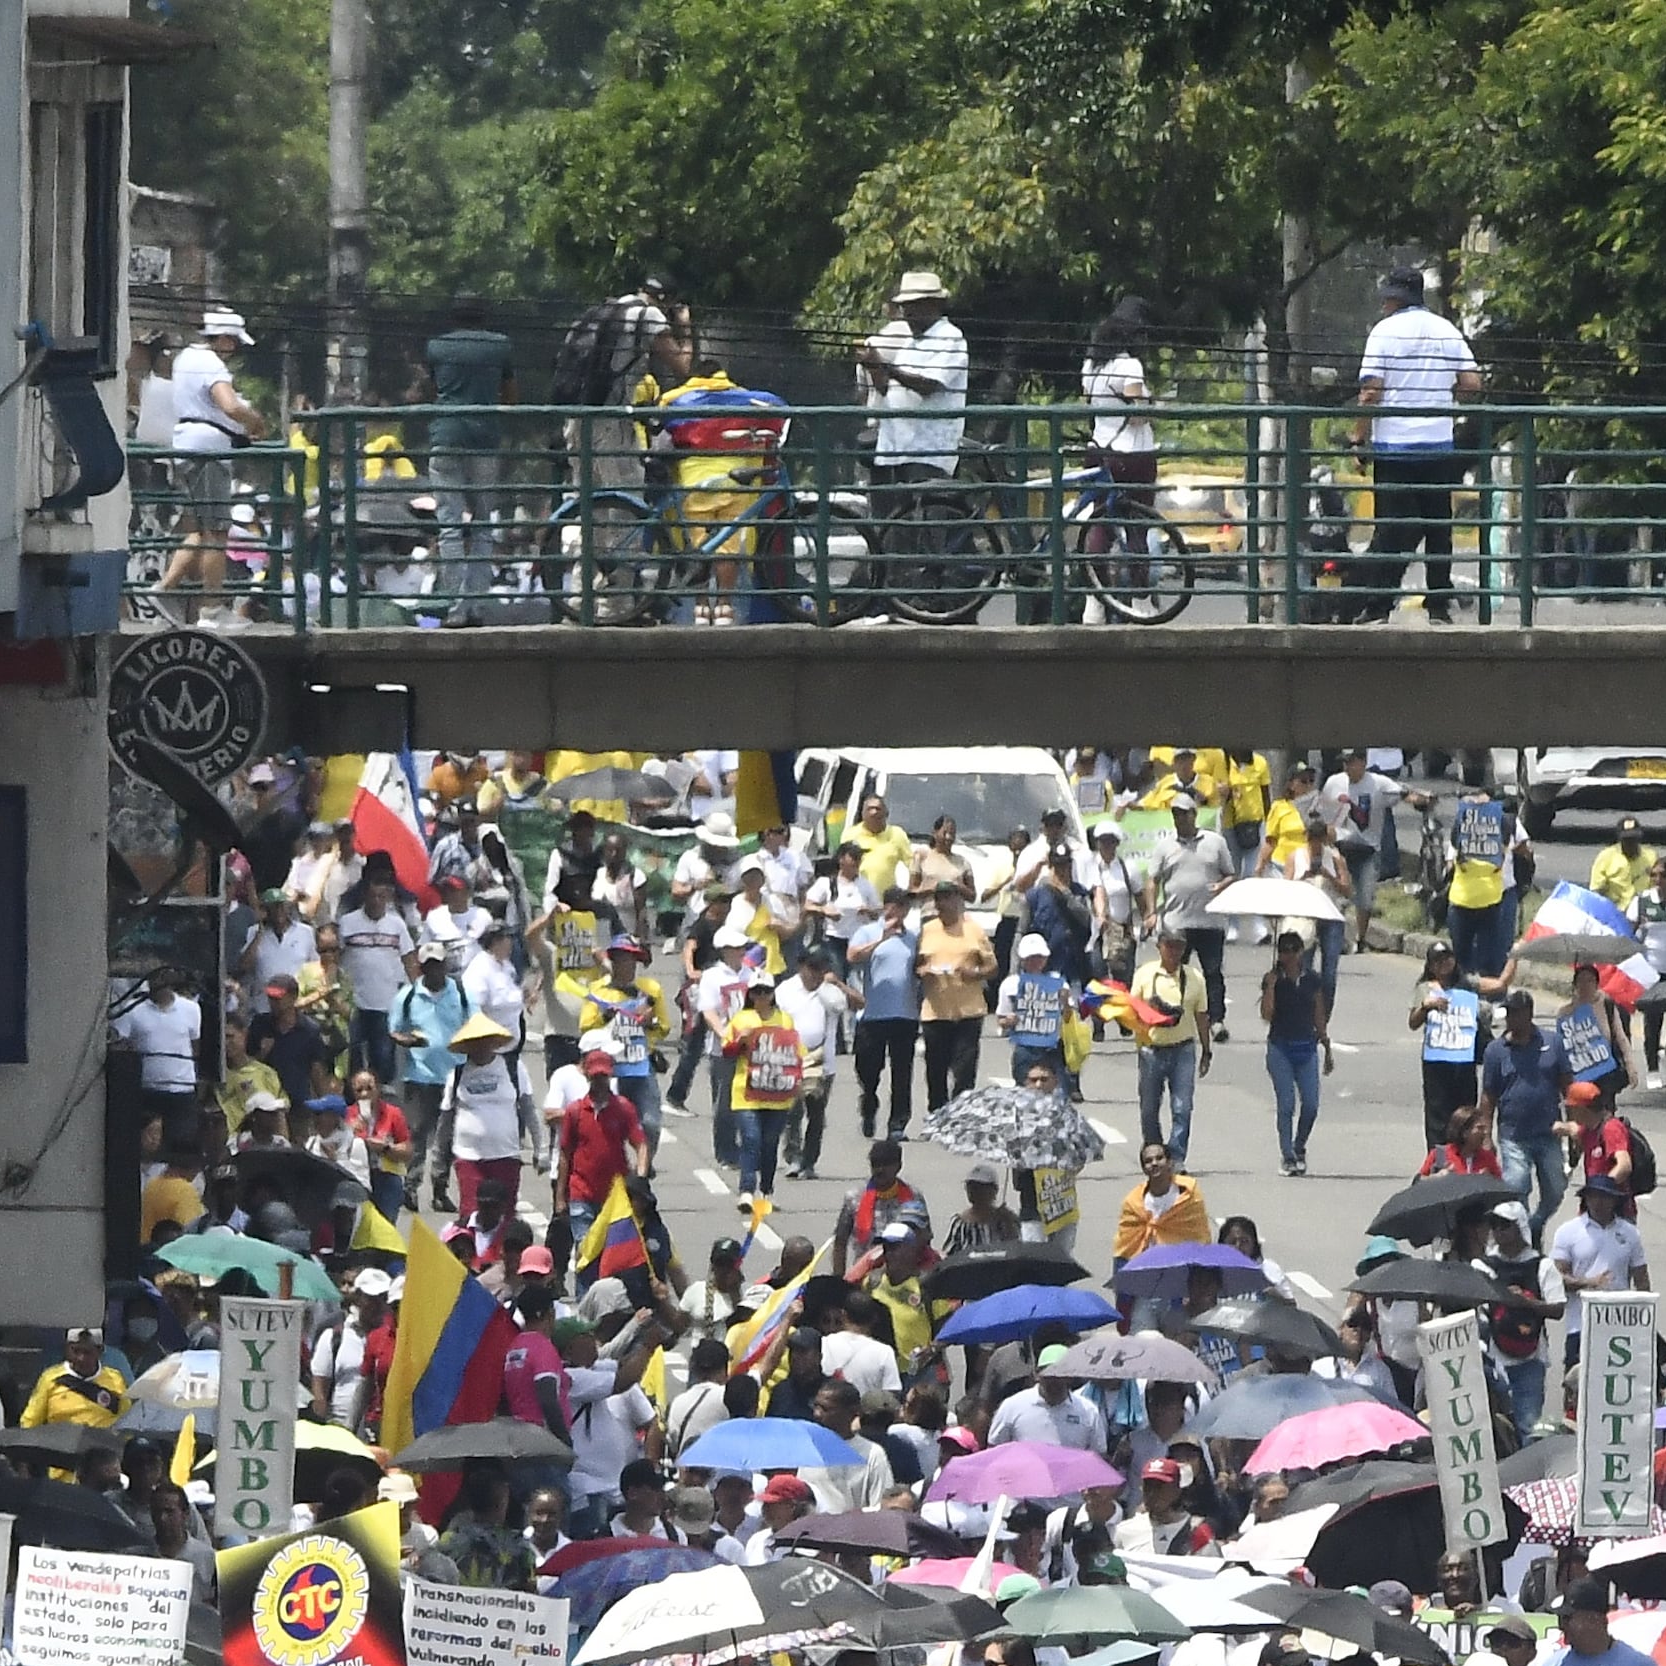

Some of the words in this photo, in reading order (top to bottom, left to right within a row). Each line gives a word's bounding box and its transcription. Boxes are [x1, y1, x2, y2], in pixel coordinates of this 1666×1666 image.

[125, 636, 242, 682] LICORES
[1461, 840, 1499, 855] SALUD
[227, 1309, 296, 1333] SUTEV
[1593, 1304, 1652, 1328] YUMBO
[1428, 1324, 1472, 1354] SUTEV
[231, 1339, 280, 1531] YUMBO
[1600, 1335, 1637, 1522] SUTEV
[1440, 1354, 1492, 1542] YUMBO
[32, 1555, 58, 1571] Los
[27, 1573, 123, 1596] neoliberales
[25, 1588, 130, 1613] instituciones
[148, 1601, 172, 1616] del
[277, 1579, 341, 1625] CTC
[412, 1583, 536, 1613] Transnacionales
[47, 1625, 90, 1645] lucros
[94, 1616, 126, 1630] solo
[132, 1620, 169, 1635] para
[496, 1618, 516, 1633] en
[525, 1619, 547, 1636] las
[21, 1644, 92, 1660] seguimos
[410, 1626, 483, 1648] reformas
[489, 1635, 513, 1651] del
[513, 1642, 562, 1659] pueblo
